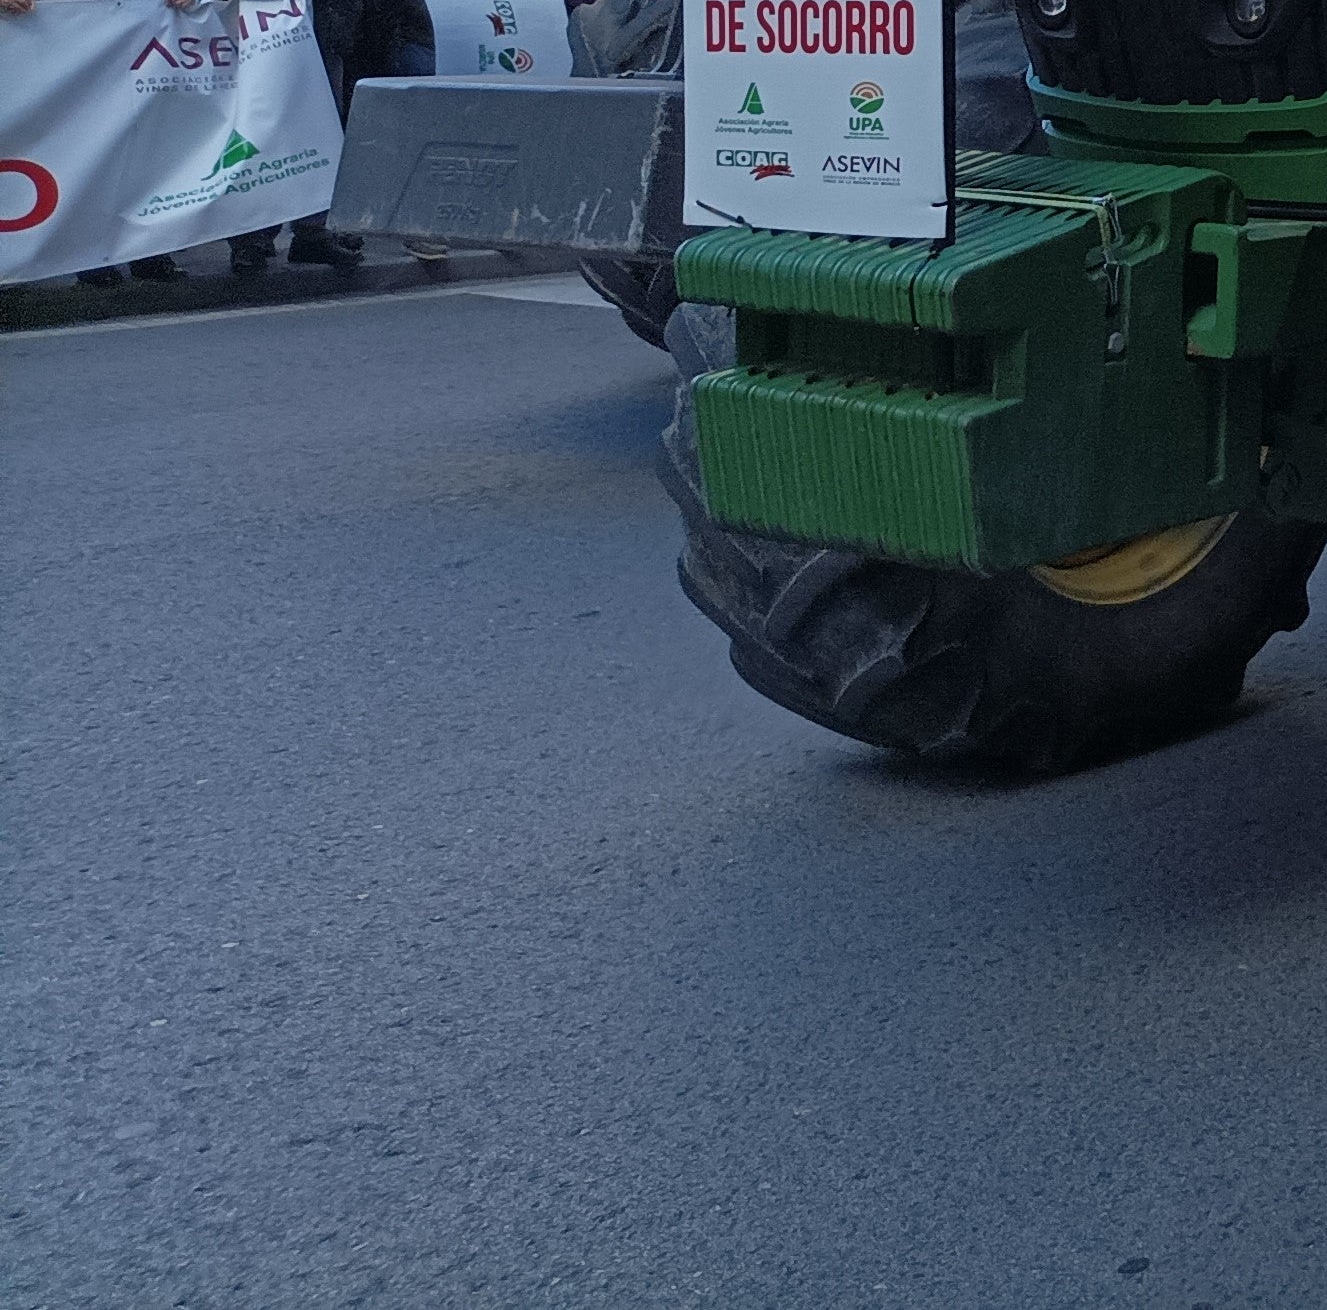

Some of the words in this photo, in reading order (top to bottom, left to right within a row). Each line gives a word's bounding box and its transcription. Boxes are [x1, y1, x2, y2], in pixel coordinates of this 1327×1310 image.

[848, 116, 884, 132] UPA
[257, 147, 319, 173] Agraria
[716, 149, 789, 167] COAG
[223, 156, 331, 196] Agricultores
